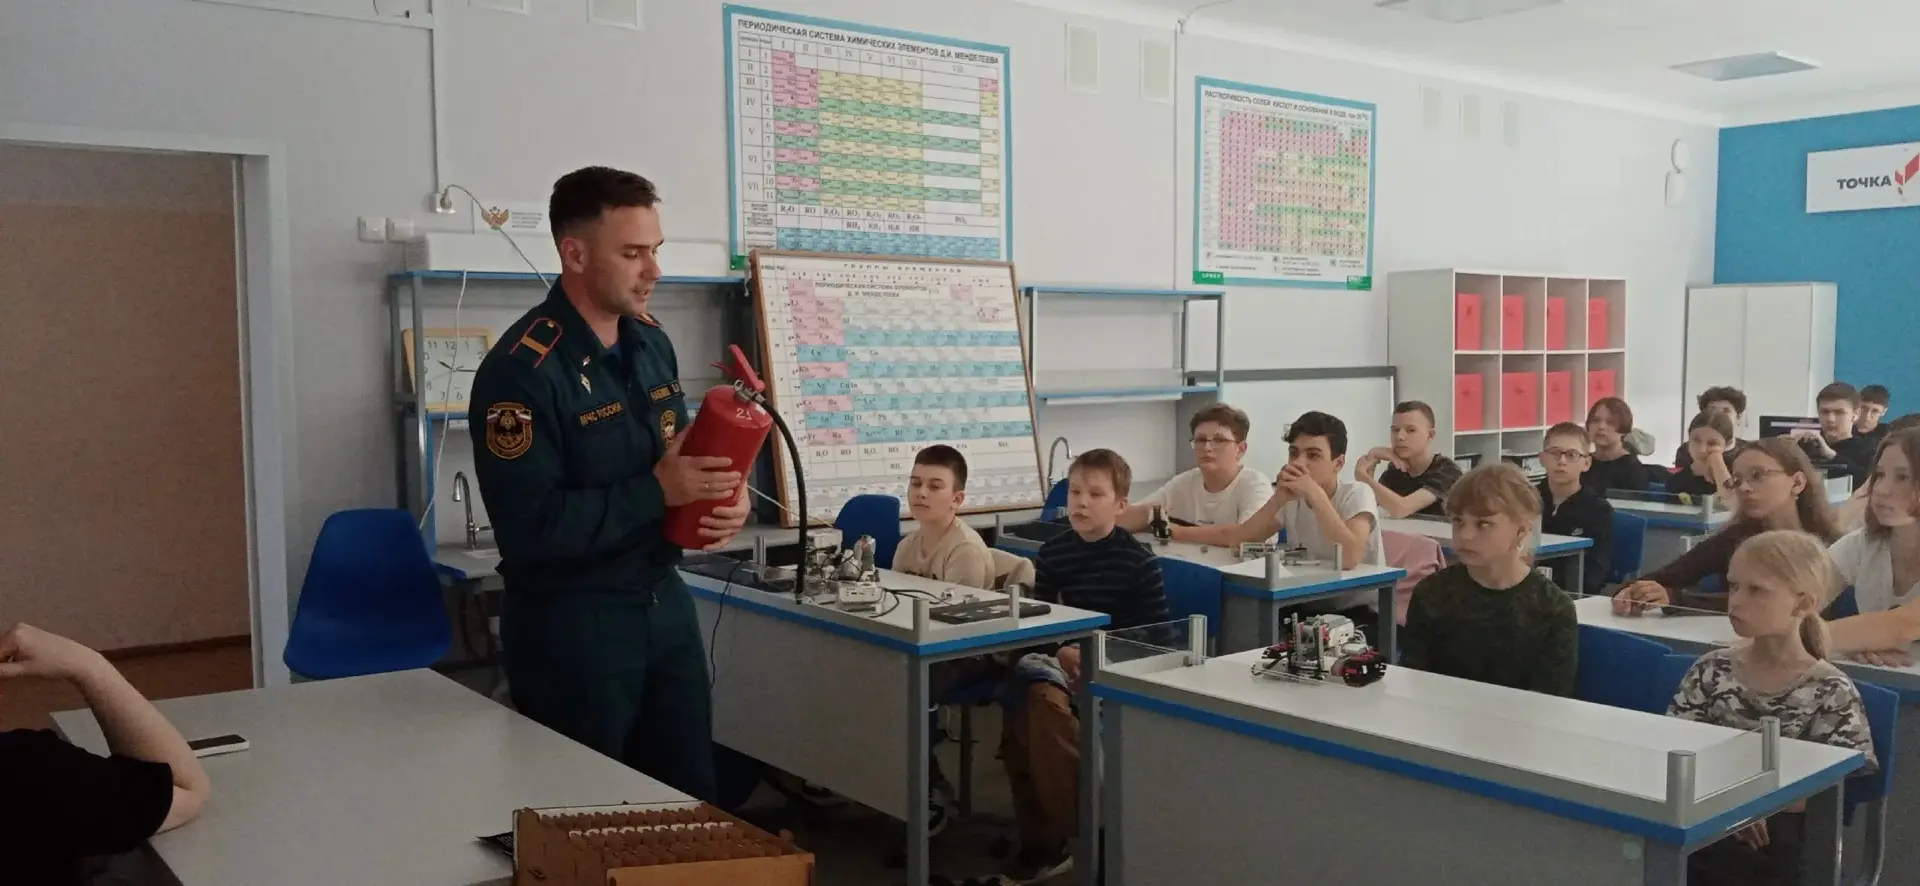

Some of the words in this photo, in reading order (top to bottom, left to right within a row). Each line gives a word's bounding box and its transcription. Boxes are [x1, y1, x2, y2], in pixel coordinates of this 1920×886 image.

[738, 19, 808, 37] ПЕРИОДИЧЕСКАЯ
[809, 30, 845, 42] СИСТЕМА
[846, 36, 896, 49] ХИМИЧЕСКИХ
[897, 43, 939, 57] ЭЛЕМЕНТОВ
[954, 51, 998, 64] МЕНДЕЛЕЕВА
[1836, 175, 1892, 190] ТОЧКА
[428, 340, 437, 349] 11
[445, 340, 457, 350] 12
[426, 380, 432, 390] 8
[456, 391, 464, 401] 6
[580, 410, 599, 426] МЧС
[597, 401, 622, 418] РОССИИ
